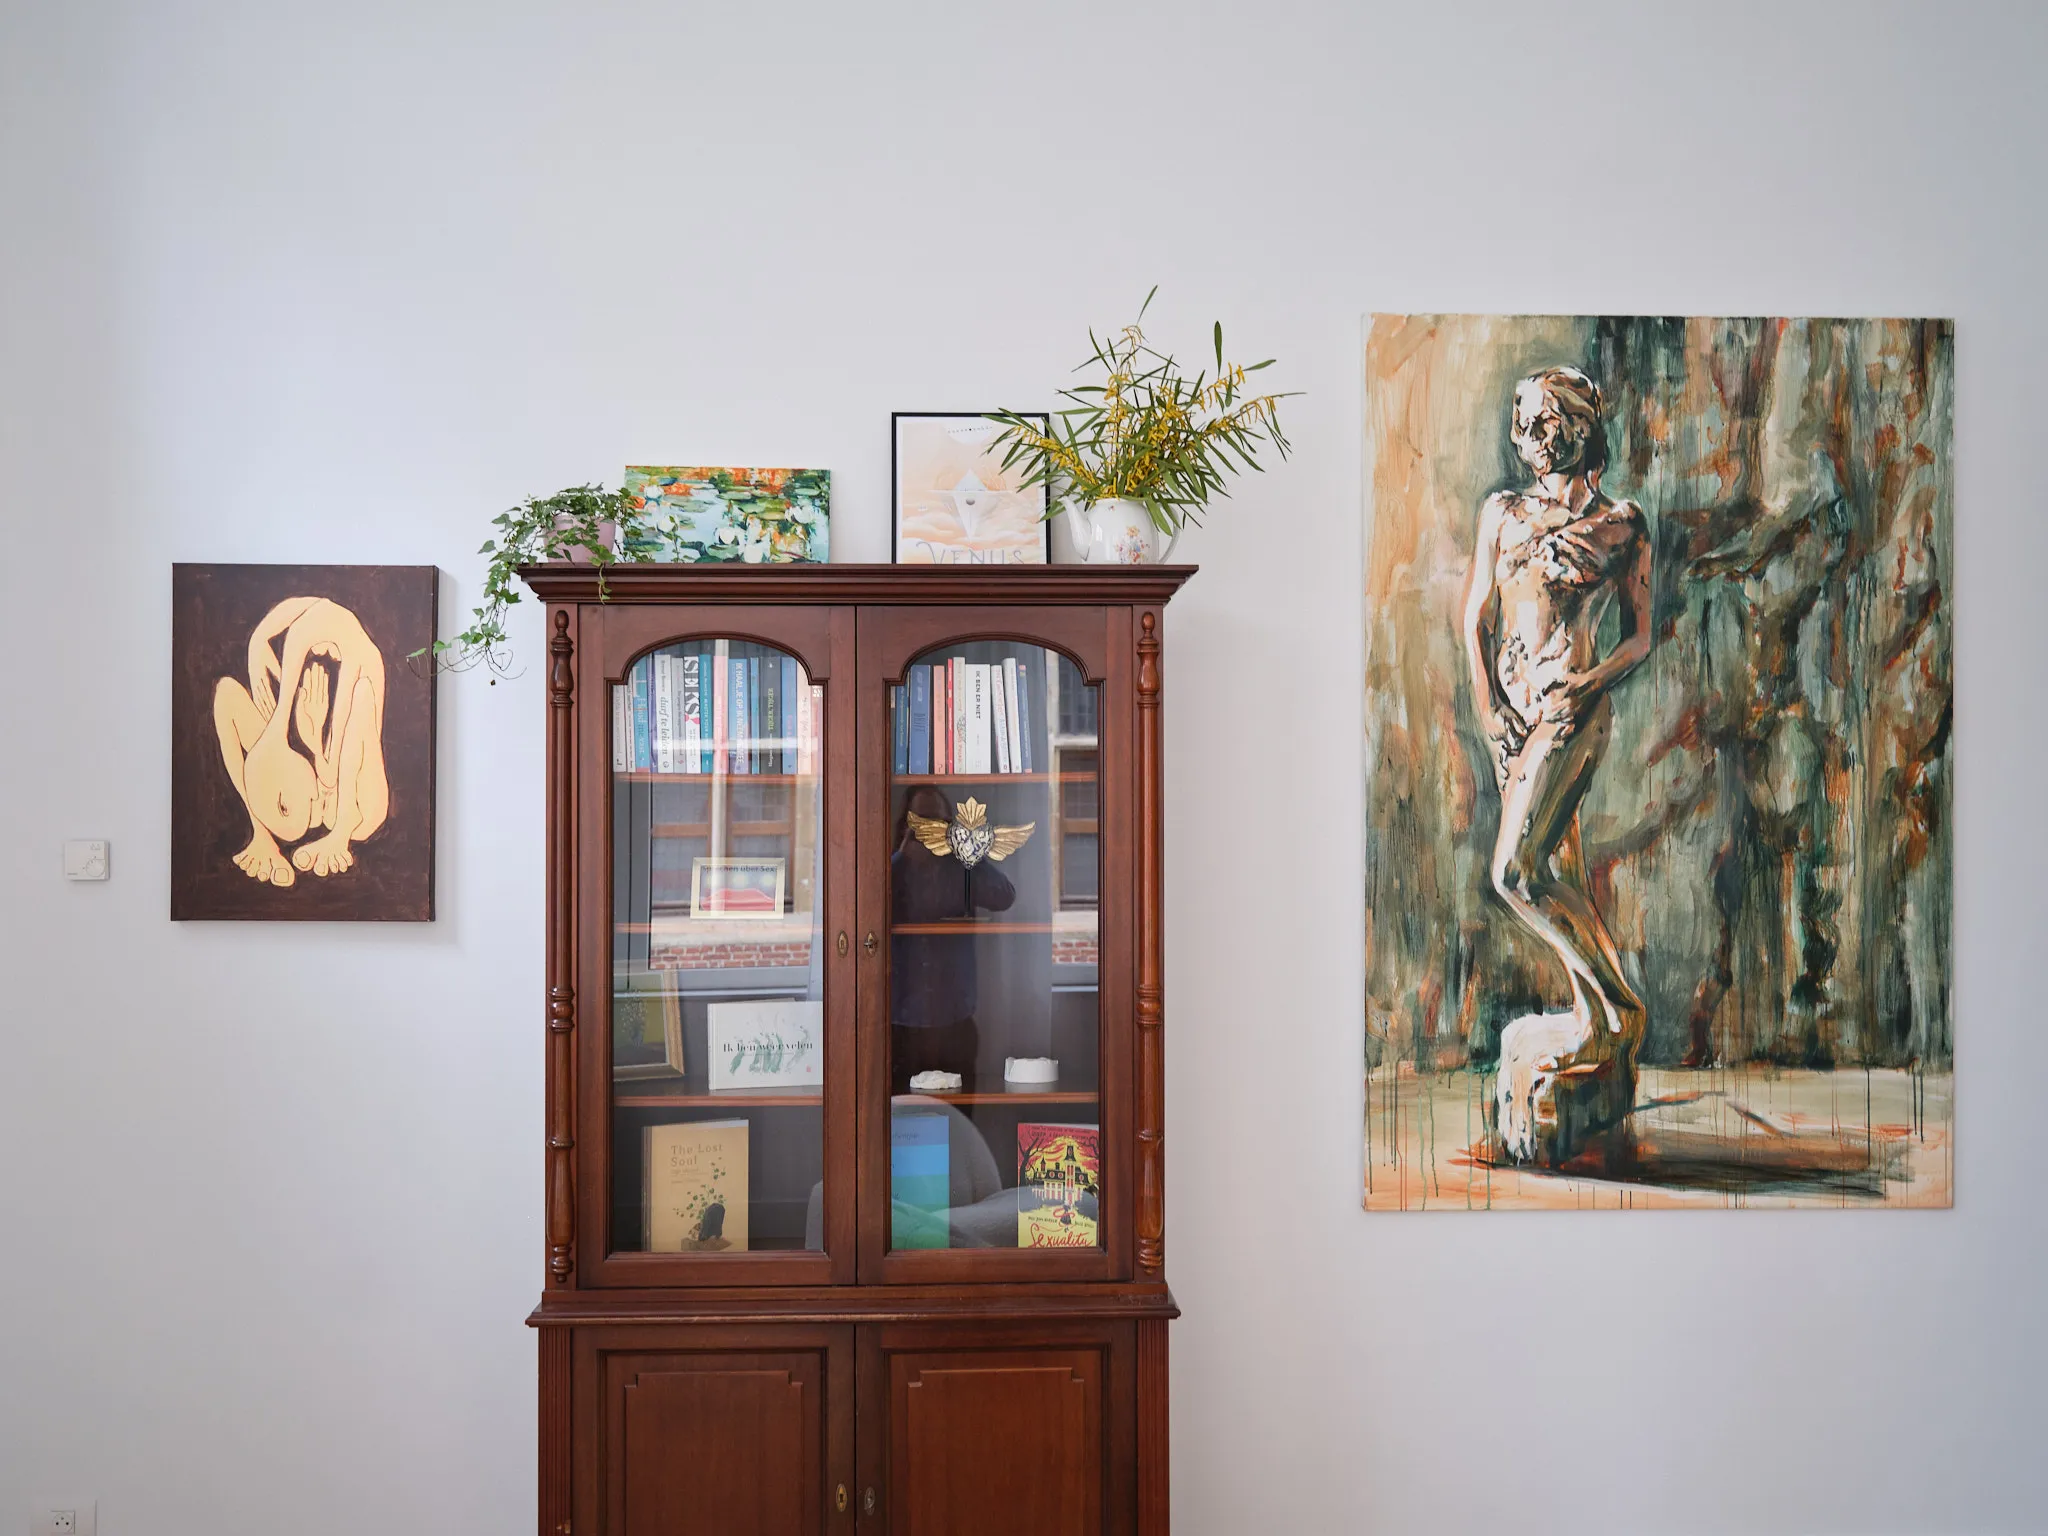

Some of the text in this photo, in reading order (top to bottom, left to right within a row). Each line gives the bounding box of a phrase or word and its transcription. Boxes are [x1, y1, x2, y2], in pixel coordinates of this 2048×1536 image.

[915, 541, 1025, 564] VENUS
[735, 662, 743, 670] IK
[735, 670, 743, 689] HAAL
[975, 670, 981, 678] IK
[736, 689, 743, 699] JE
[975, 694, 981, 703] ER
[659, 696, 670, 717] durf
[661, 718, 668, 727] te
[723, 1040, 813, 1052] Ik ben weer velen
[670, 1143, 724, 1155] The Lost
[670, 1155, 697, 1167] Soul
[1028, 1222, 1093, 1248] Sexuality
